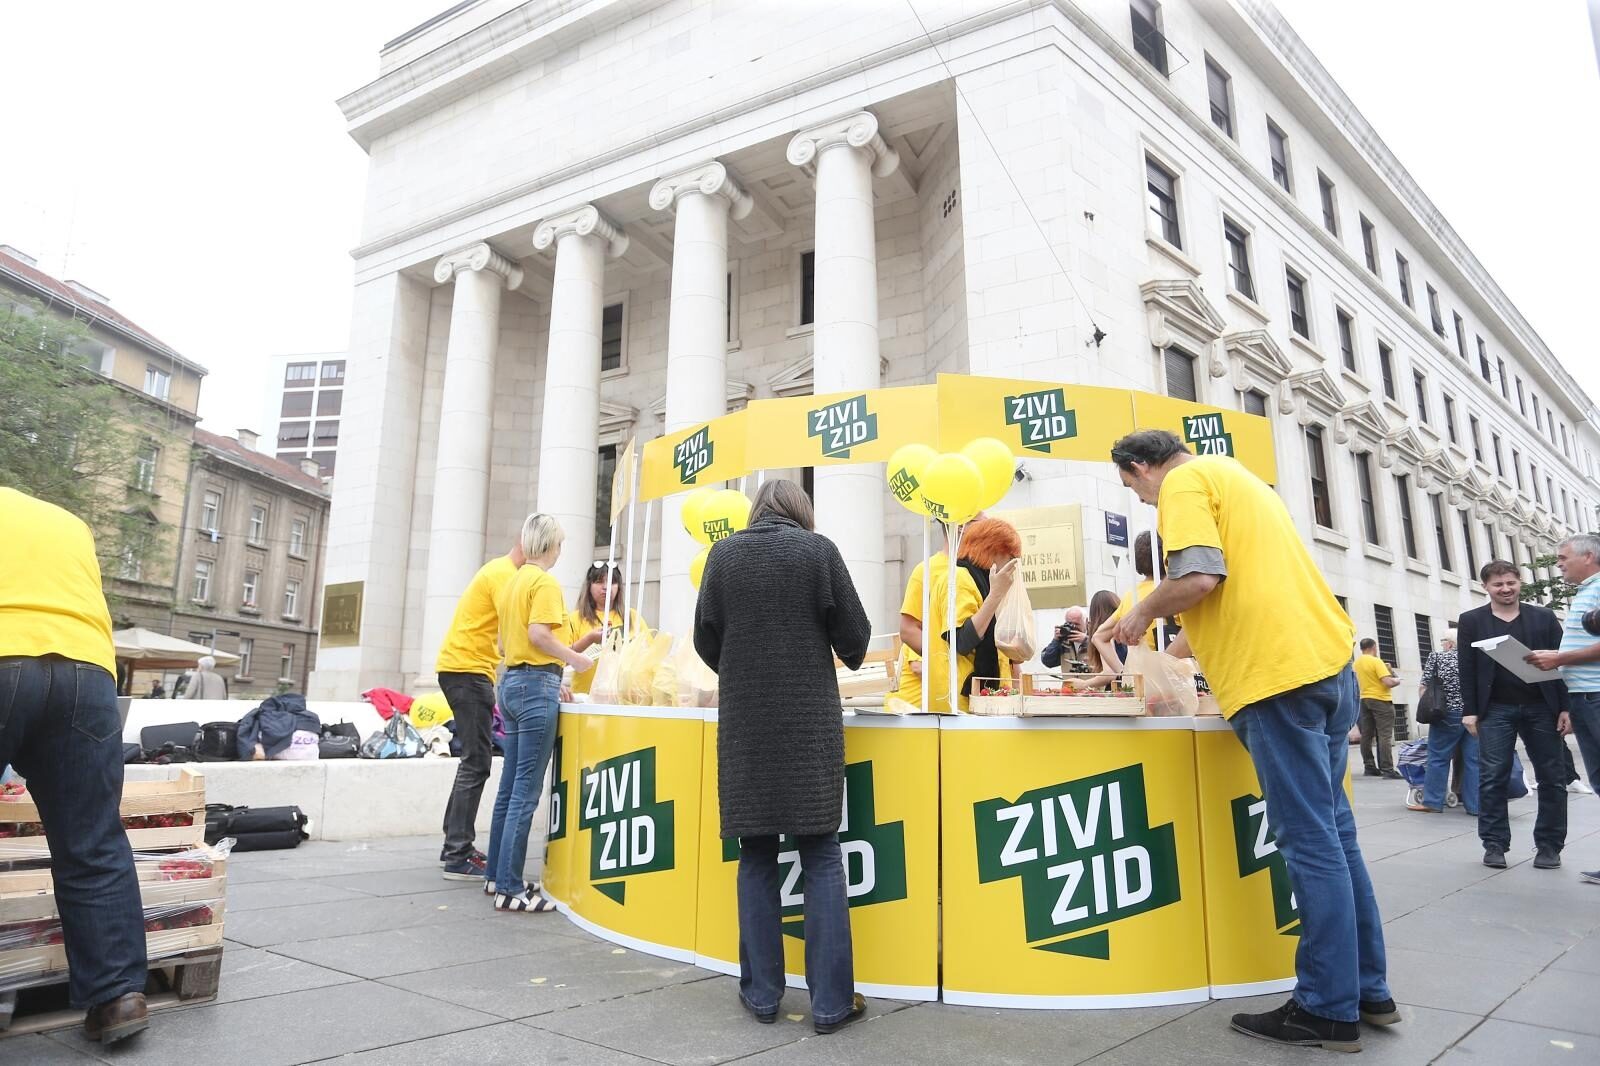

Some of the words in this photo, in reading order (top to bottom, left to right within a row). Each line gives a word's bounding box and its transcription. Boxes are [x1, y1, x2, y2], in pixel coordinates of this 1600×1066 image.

[829, 420, 867, 449] ZID
[1028, 415, 1067, 441] ZID
[1200, 437, 1228, 456] ZID
[685, 448, 708, 477] ZID
[896, 480, 914, 499] ZID
[1041, 568, 1071, 582] BANKA
[599, 814, 656, 871] ZID
[777, 839, 876, 908] ZD
[1046, 845, 1153, 926] ZID
